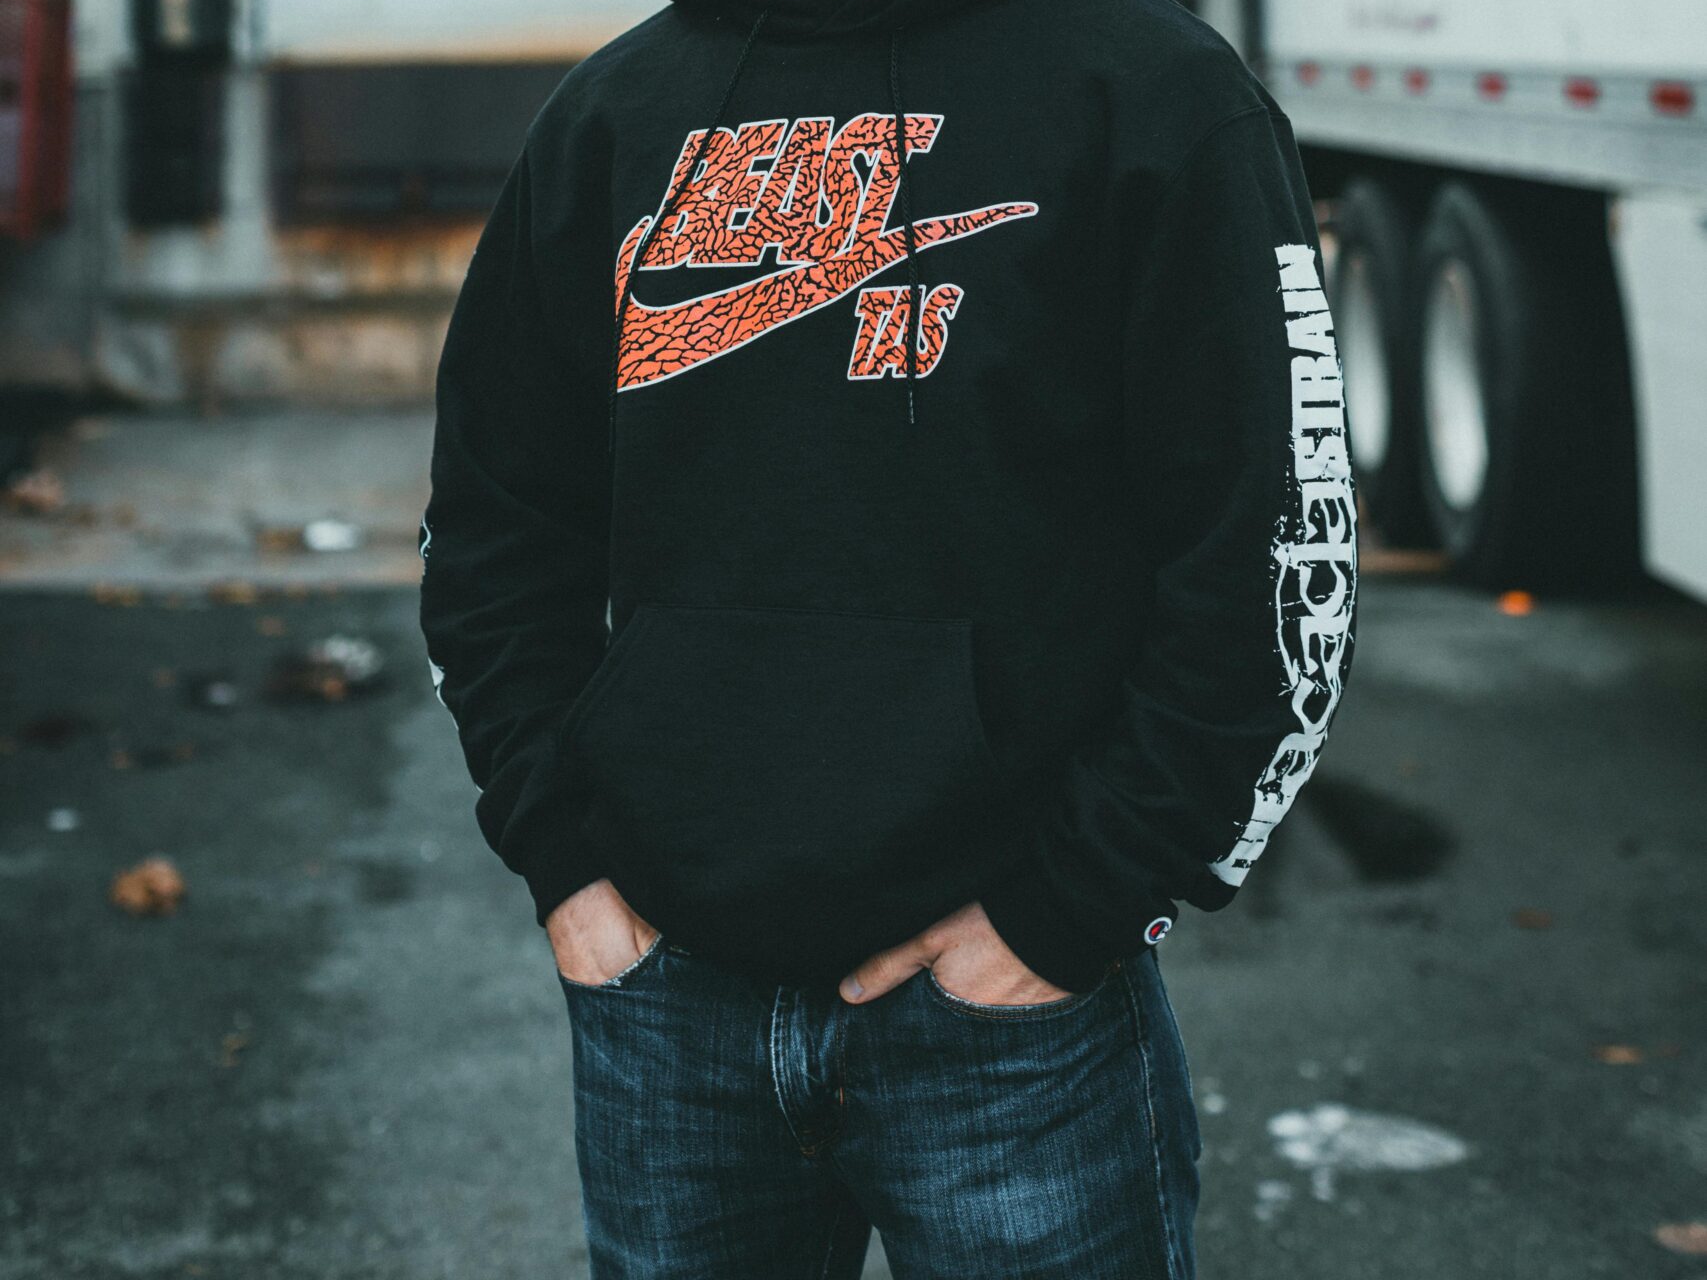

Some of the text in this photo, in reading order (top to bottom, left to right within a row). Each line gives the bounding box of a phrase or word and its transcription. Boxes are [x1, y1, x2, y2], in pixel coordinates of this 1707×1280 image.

[637, 112, 944, 272] BEAST
[847, 283, 965, 380] TAS
[1274, 244, 1353, 481] STRAIN
